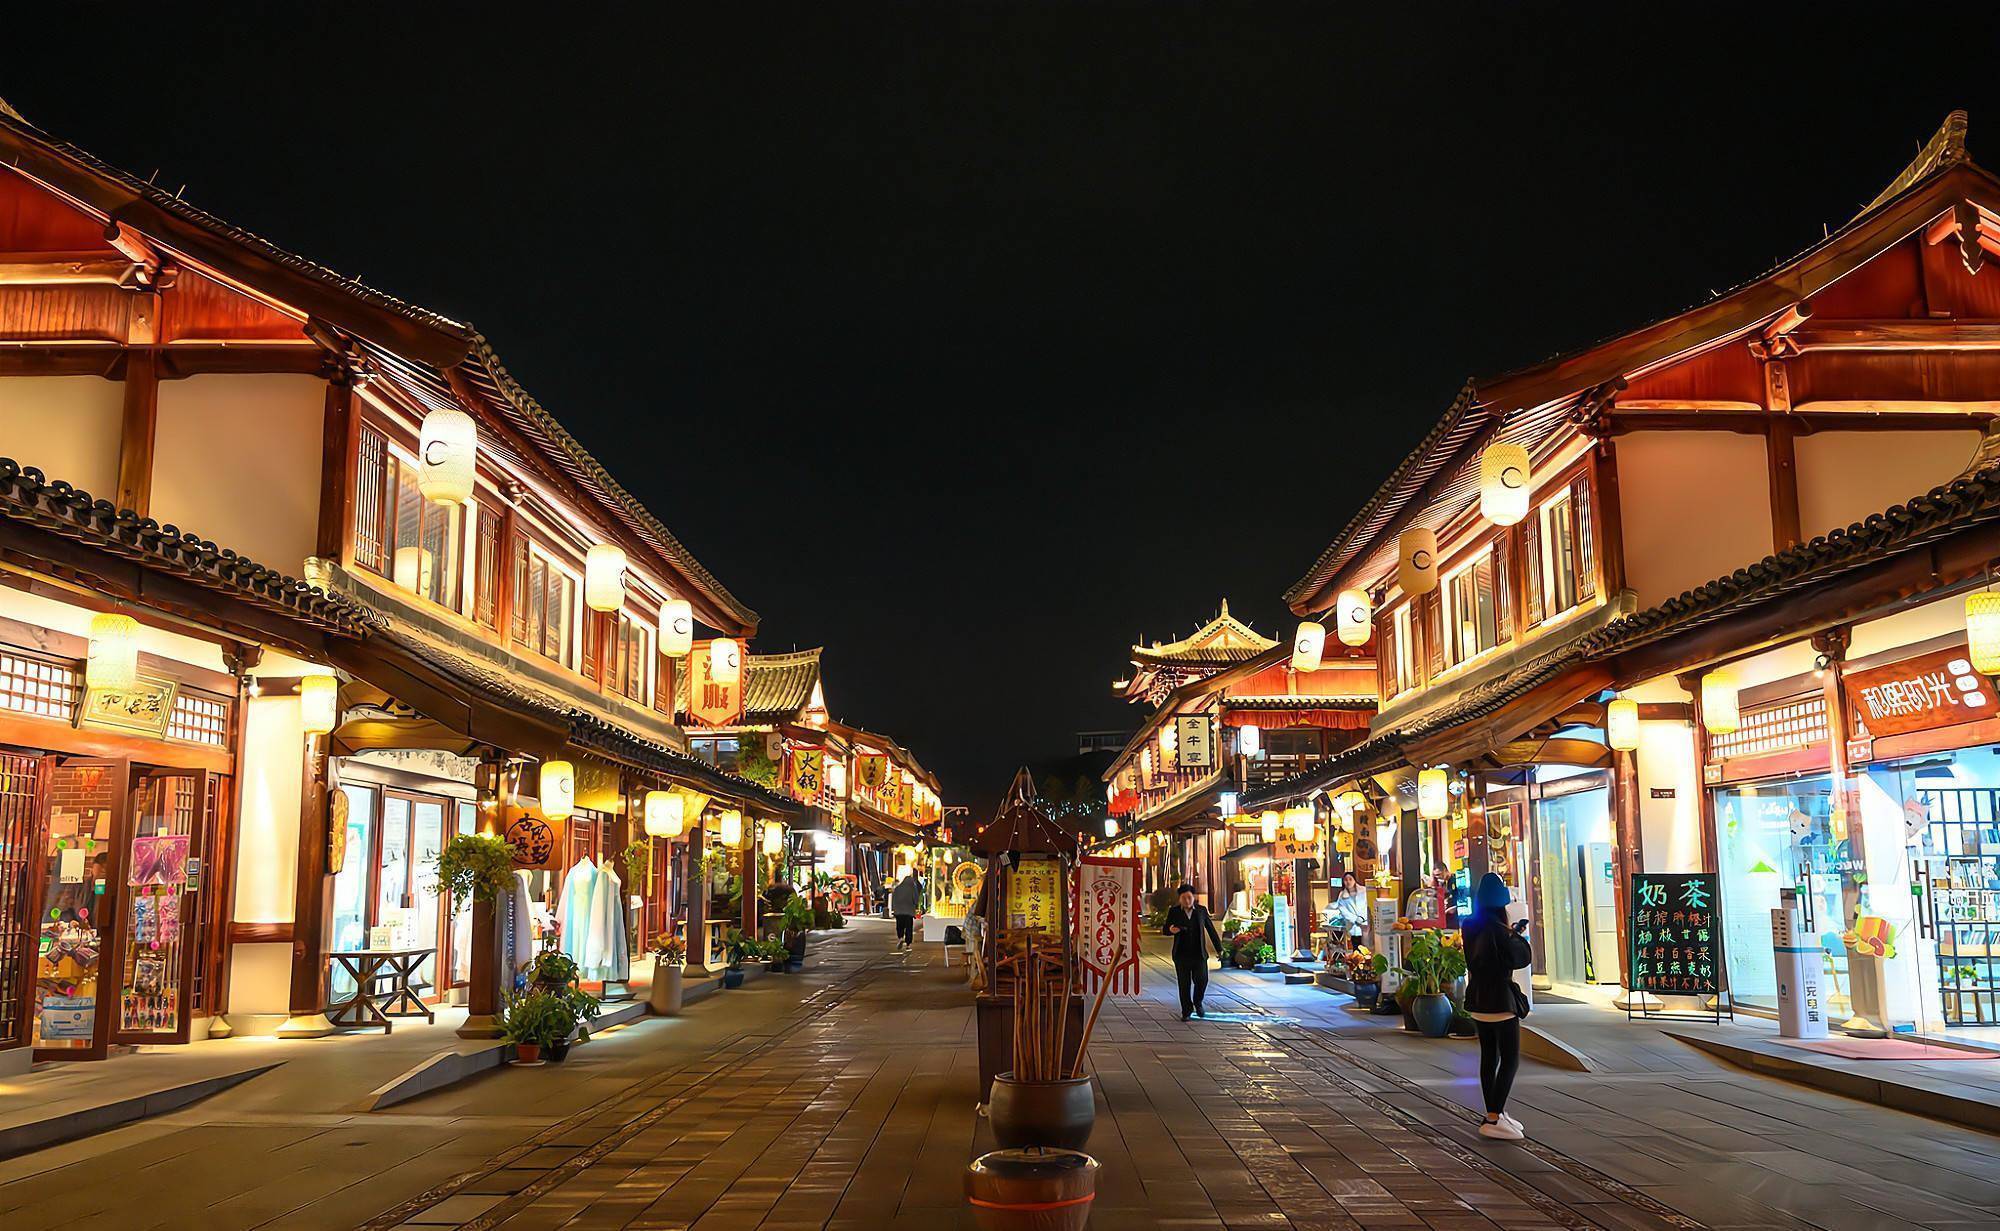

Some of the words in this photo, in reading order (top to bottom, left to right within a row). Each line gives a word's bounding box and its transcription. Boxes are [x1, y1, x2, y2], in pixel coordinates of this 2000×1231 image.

[1186, 718, 1201, 763] 全牛宴
[797, 752, 819, 791] 火锅
[1638, 880, 1711, 909] 奶茶
[1806, 986, 1819, 1022] 充电宝
